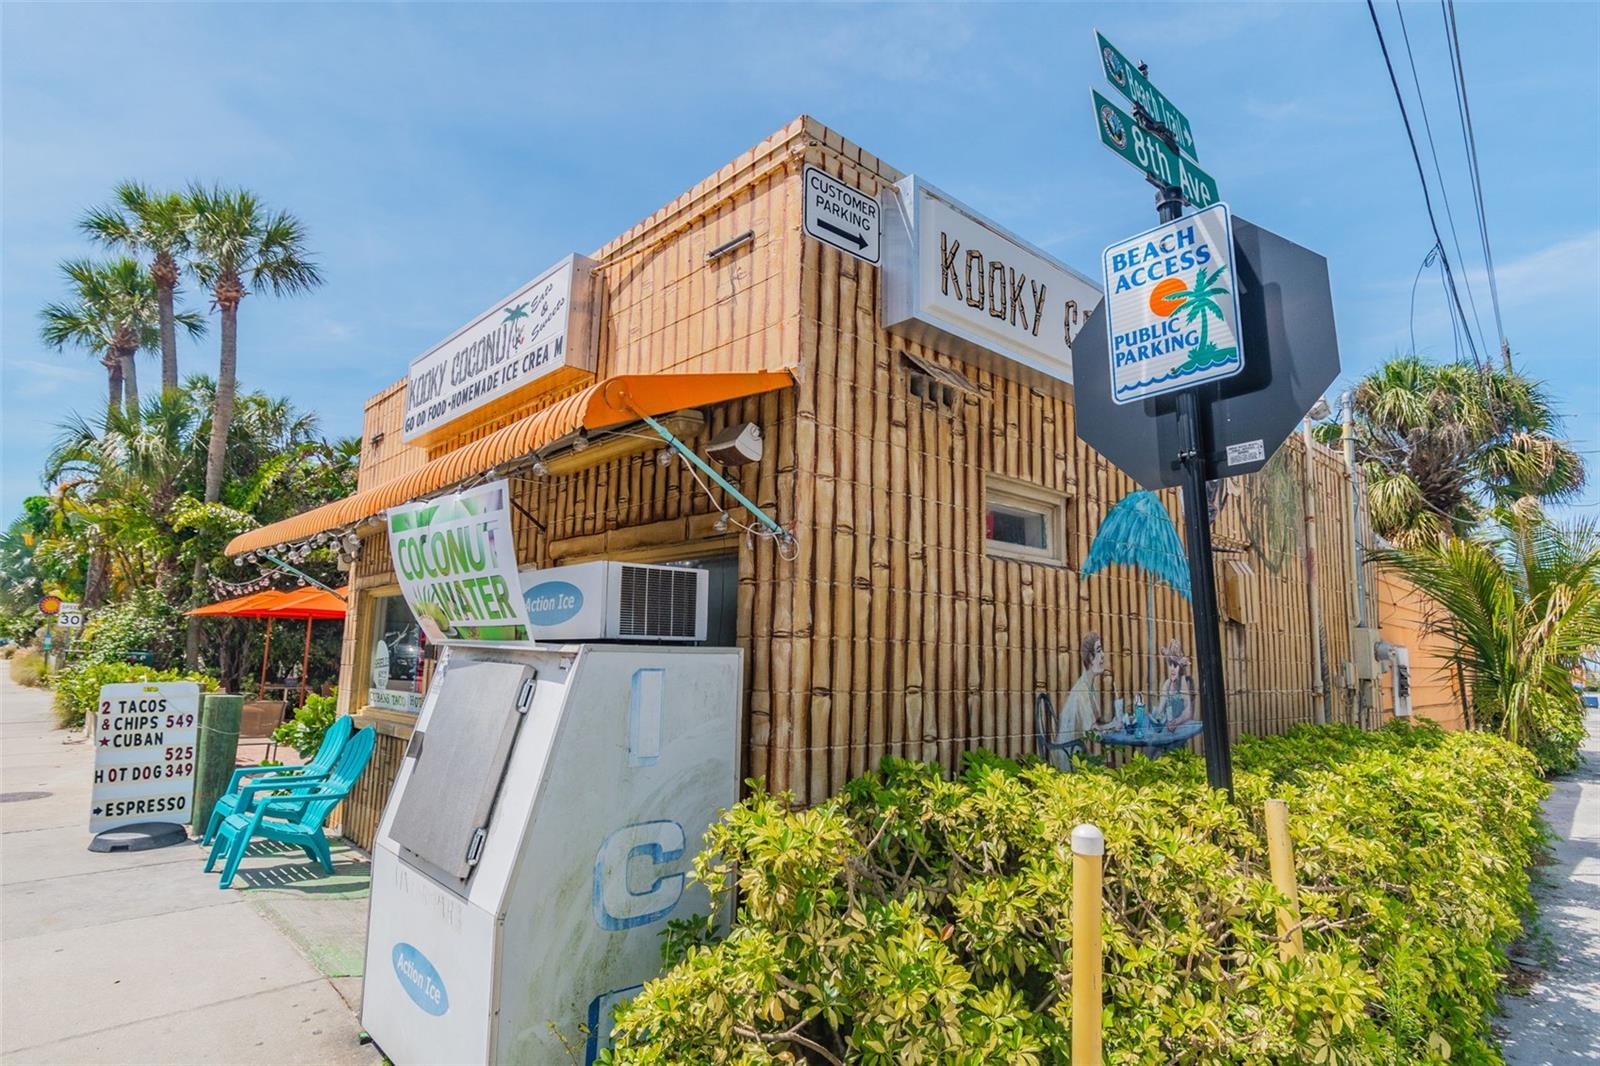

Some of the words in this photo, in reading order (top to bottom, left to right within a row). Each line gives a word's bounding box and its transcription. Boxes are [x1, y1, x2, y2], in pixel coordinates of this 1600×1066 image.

[1125, 63, 1160, 121] Beach
[1159, 96, 1185, 147] Trail
[1131, 125, 1171, 184] 8th
[1178, 159, 1211, 208] Ave
[810, 176, 876, 218] CUSTOMER
[816, 195, 871, 231] PARKING
[1112, 226, 1196, 273] BEACH
[1115, 244, 1211, 294] ACCESS
[941, 231, 1047, 337] KOOKY
[1114, 317, 1181, 351] PUBLIC
[1116, 330, 1200, 368] PARKING
[407, 359, 448, 411] KOOKY
[427, 400, 447, 422] FOOD
[501, 360, 519, 385] ICE
[397, 519, 499, 581] COCONUT
[430, 575, 518, 622] WATER
[525, 593, 556, 613] Action
[557, 592, 575, 609] Ice
[61, 615, 80, 624] 30
[102, 701, 111, 714] 2
[119, 699, 167, 714] TACOS
[102, 718, 110, 731] &
[114, 716, 158, 731] CHIPS
[166, 714, 194, 728] 549
[113, 732, 163, 748] CUBAN
[165, 747, 193, 761] 525
[132, 765, 162, 781] DOG
[165, 763, 193, 778] 349
[105, 796, 186, 817] ESPRESSO
[398, 953, 424, 989] Action
[424, 974, 441, 1005] Ice
